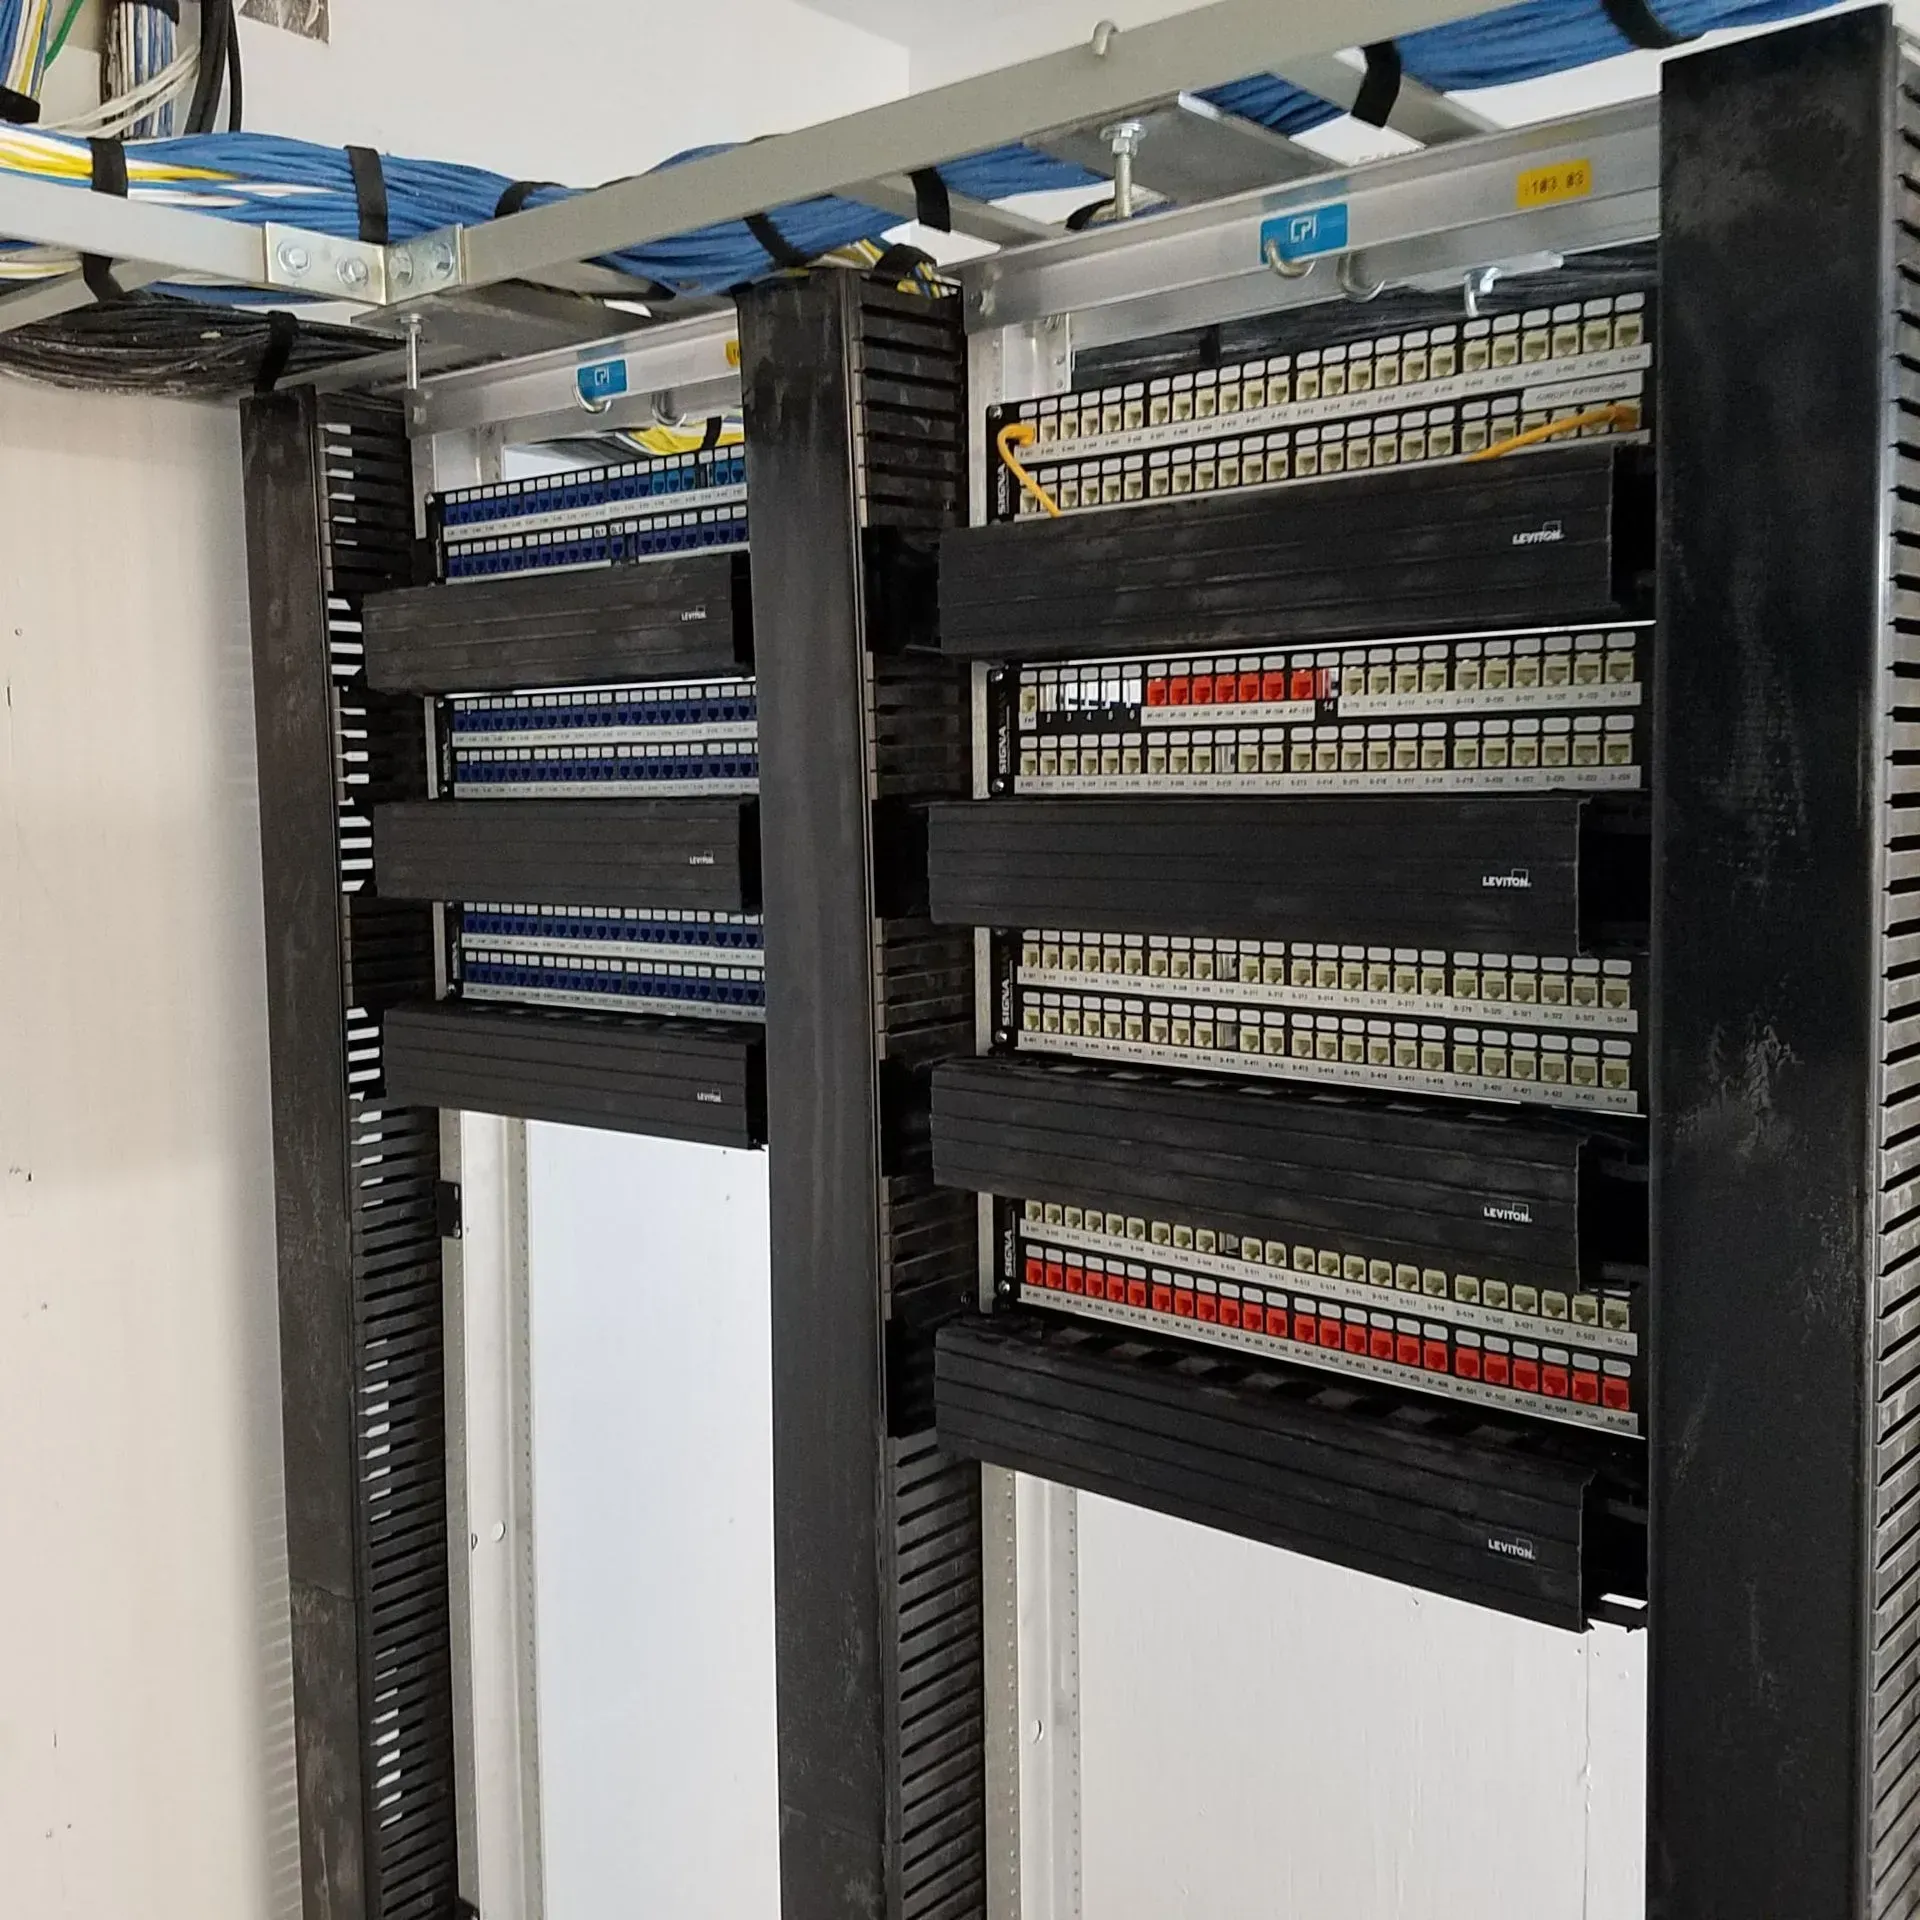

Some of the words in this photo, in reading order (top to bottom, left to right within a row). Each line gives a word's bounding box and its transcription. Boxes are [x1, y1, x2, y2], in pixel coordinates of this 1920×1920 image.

[1512, 529, 1563, 545] LEVITON
[1086, 711, 1092, 721] 4
[1482, 875, 1530, 888] LEVITON
[1483, 1206, 1532, 1223] LEVITON
[1487, 1538, 1536, 1561] LEVITON
